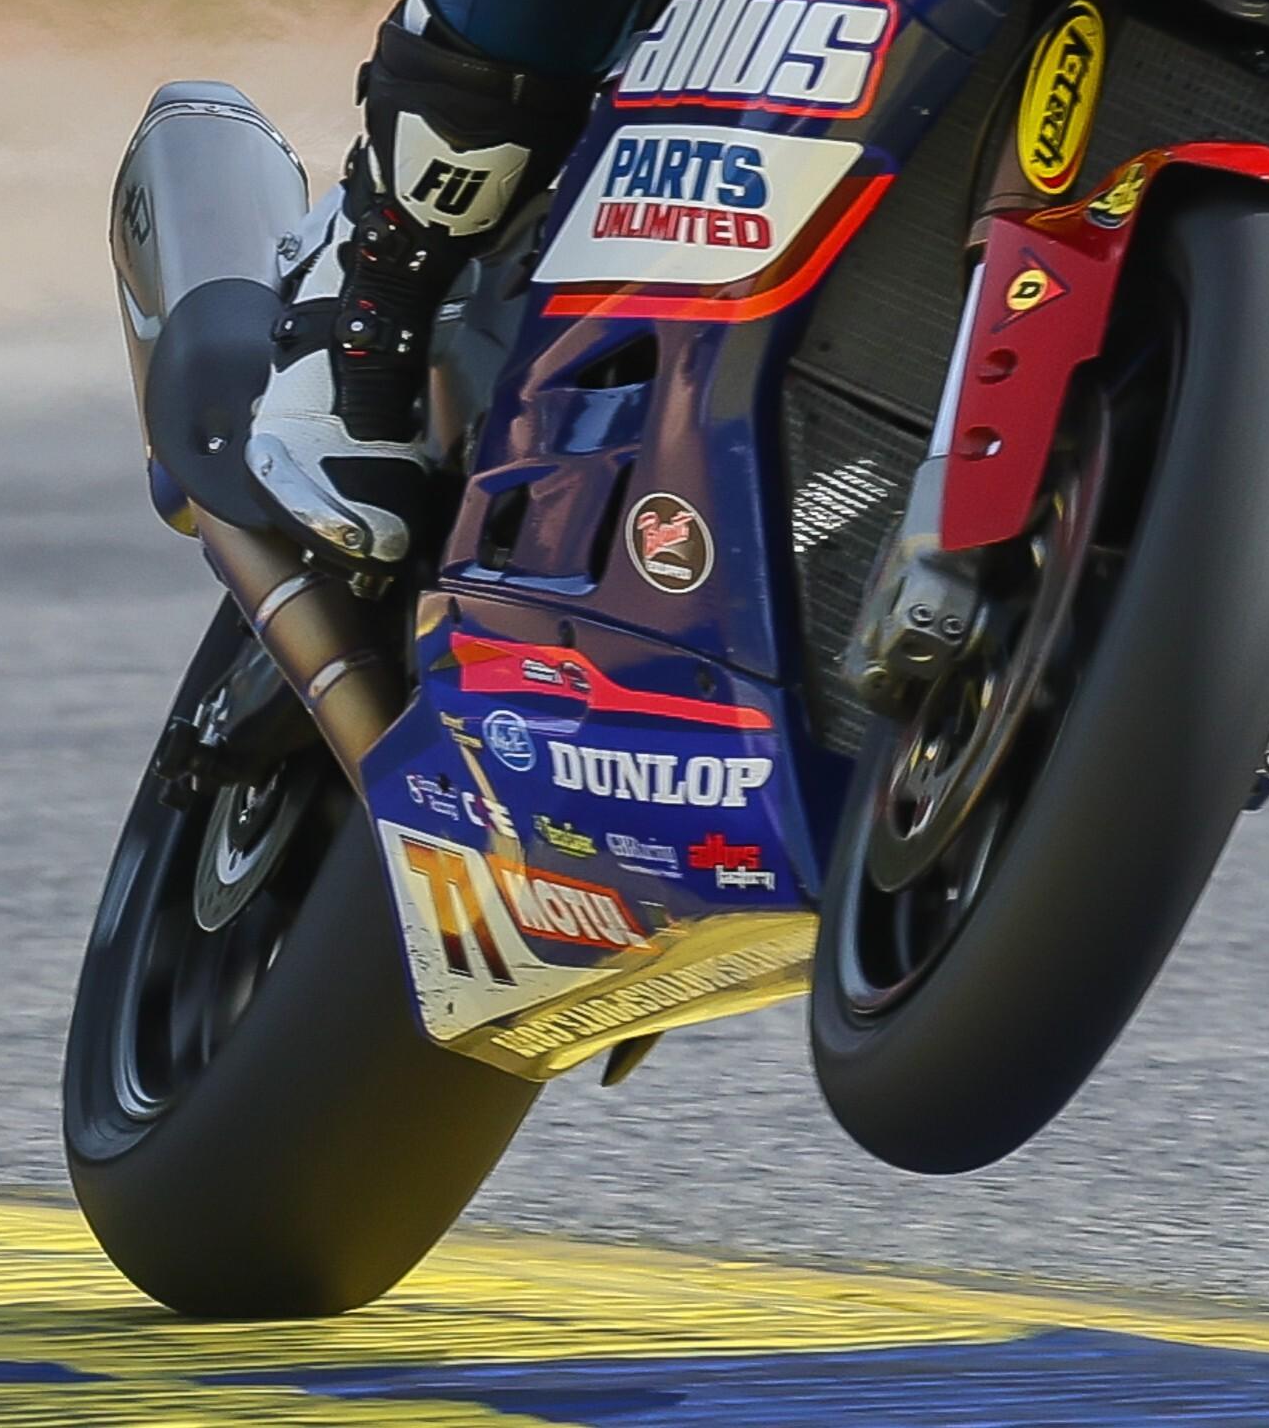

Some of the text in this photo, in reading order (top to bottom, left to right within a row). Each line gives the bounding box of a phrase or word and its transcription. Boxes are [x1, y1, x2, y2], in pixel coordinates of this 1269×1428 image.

[601, 138, 767, 209] PARTS
[592, 202, 773, 250] UNLIMITED
[547, 740, 773, 808] DUNLOP
[499, 868, 653, 949] MOTUL
